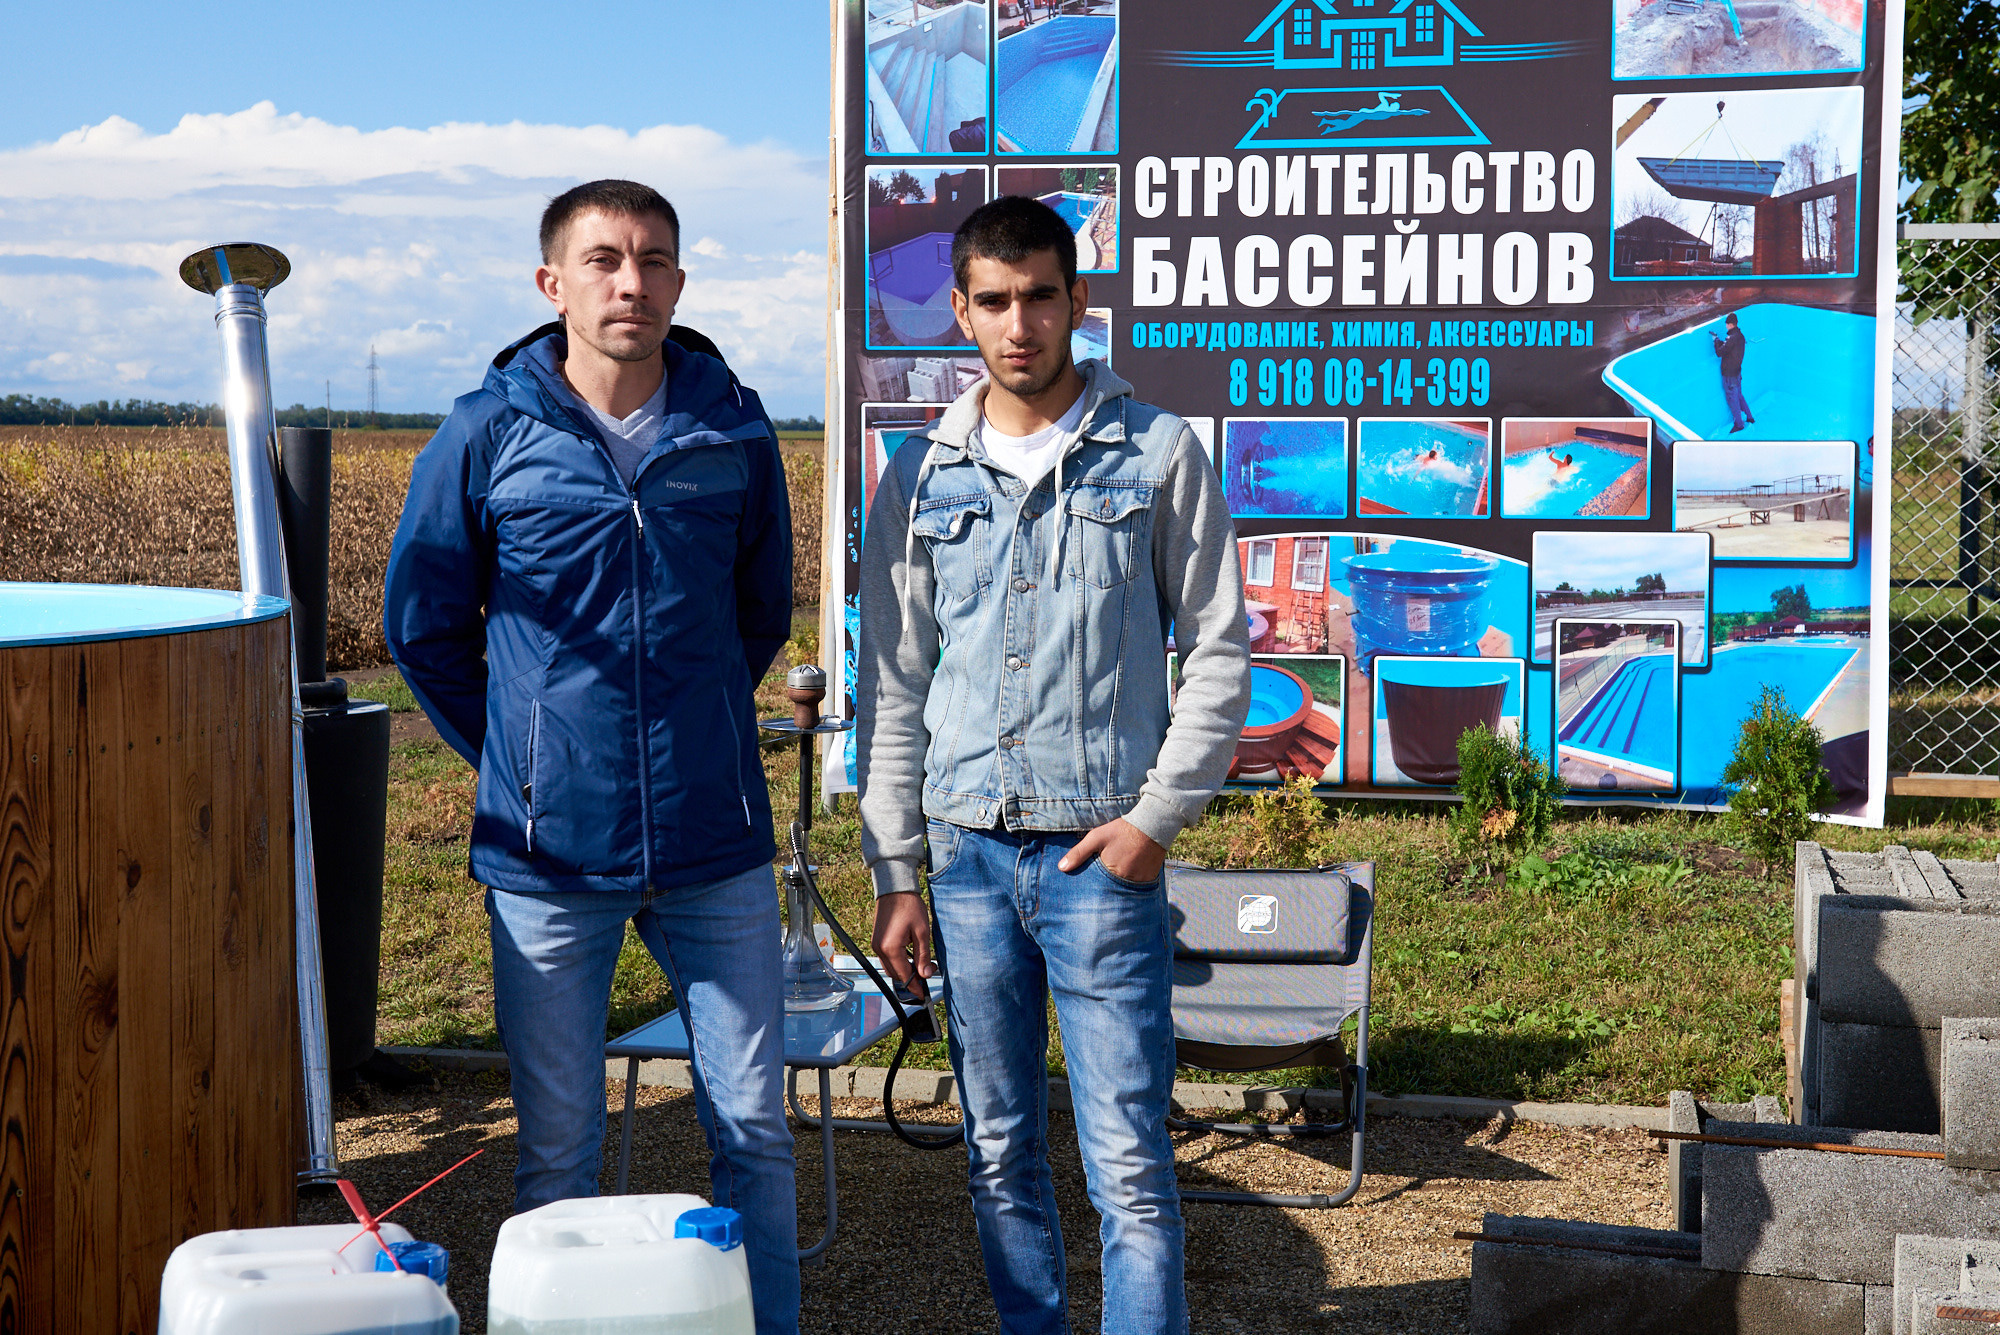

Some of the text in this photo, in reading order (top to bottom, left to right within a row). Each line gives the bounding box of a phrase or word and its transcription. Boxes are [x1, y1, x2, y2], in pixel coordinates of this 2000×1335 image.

[1134, 149, 1596, 218] СТРОИТЕЛЬСТВО
[1132, 219, 1595, 307] БАССЕЙНОВ
[1132, 320, 1594, 352] ОБОРУДОВАНИЕ, ХИМИЯ, АКСЕССУАРЫ
[1229, 357, 1491, 407] 8 918 08-14-399
